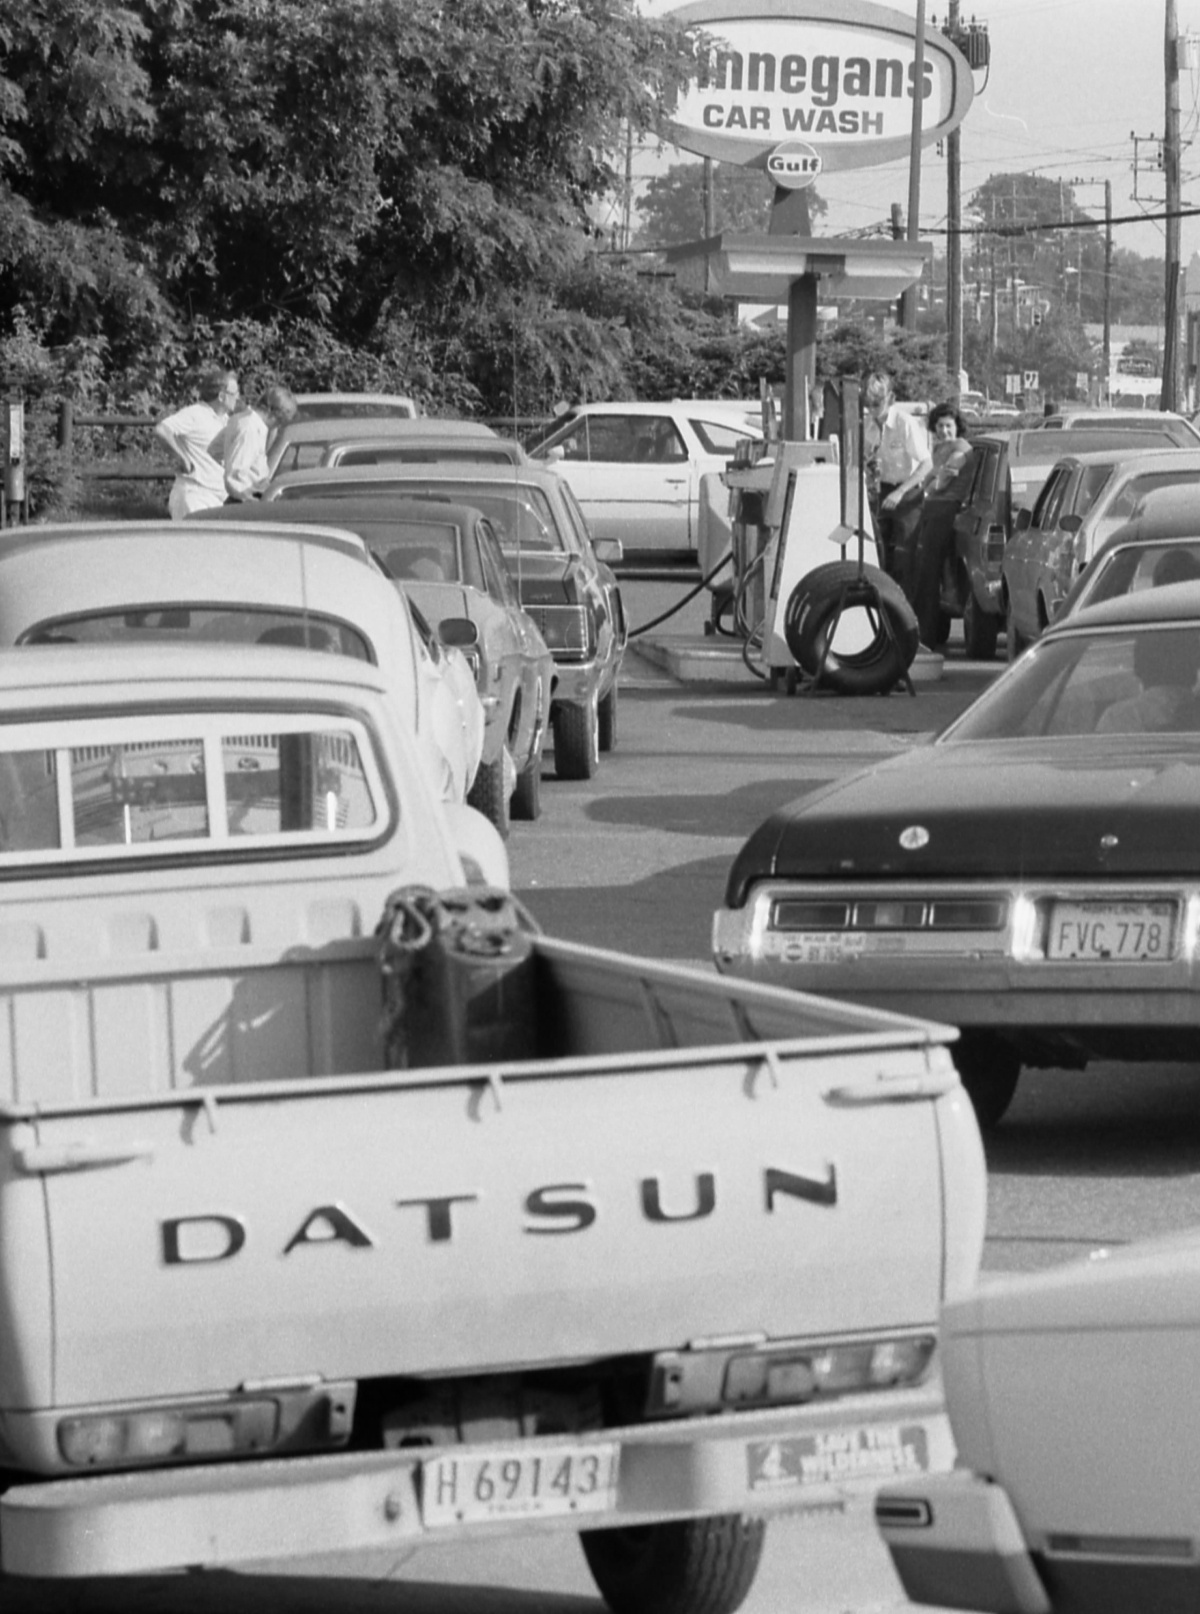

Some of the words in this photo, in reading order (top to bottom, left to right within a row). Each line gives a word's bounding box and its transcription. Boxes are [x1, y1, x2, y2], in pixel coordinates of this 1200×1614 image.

[703, 104, 770, 130] CAR
[782, 107, 883, 135] WASH
[768, 155, 819, 172] Gulf
[1058, 921, 1105, 953] FVC
[1116, 922, 1162, 953] 778
[160, 1163, 838, 1268] DATSUN
[436, 1461, 458, 1505] H
